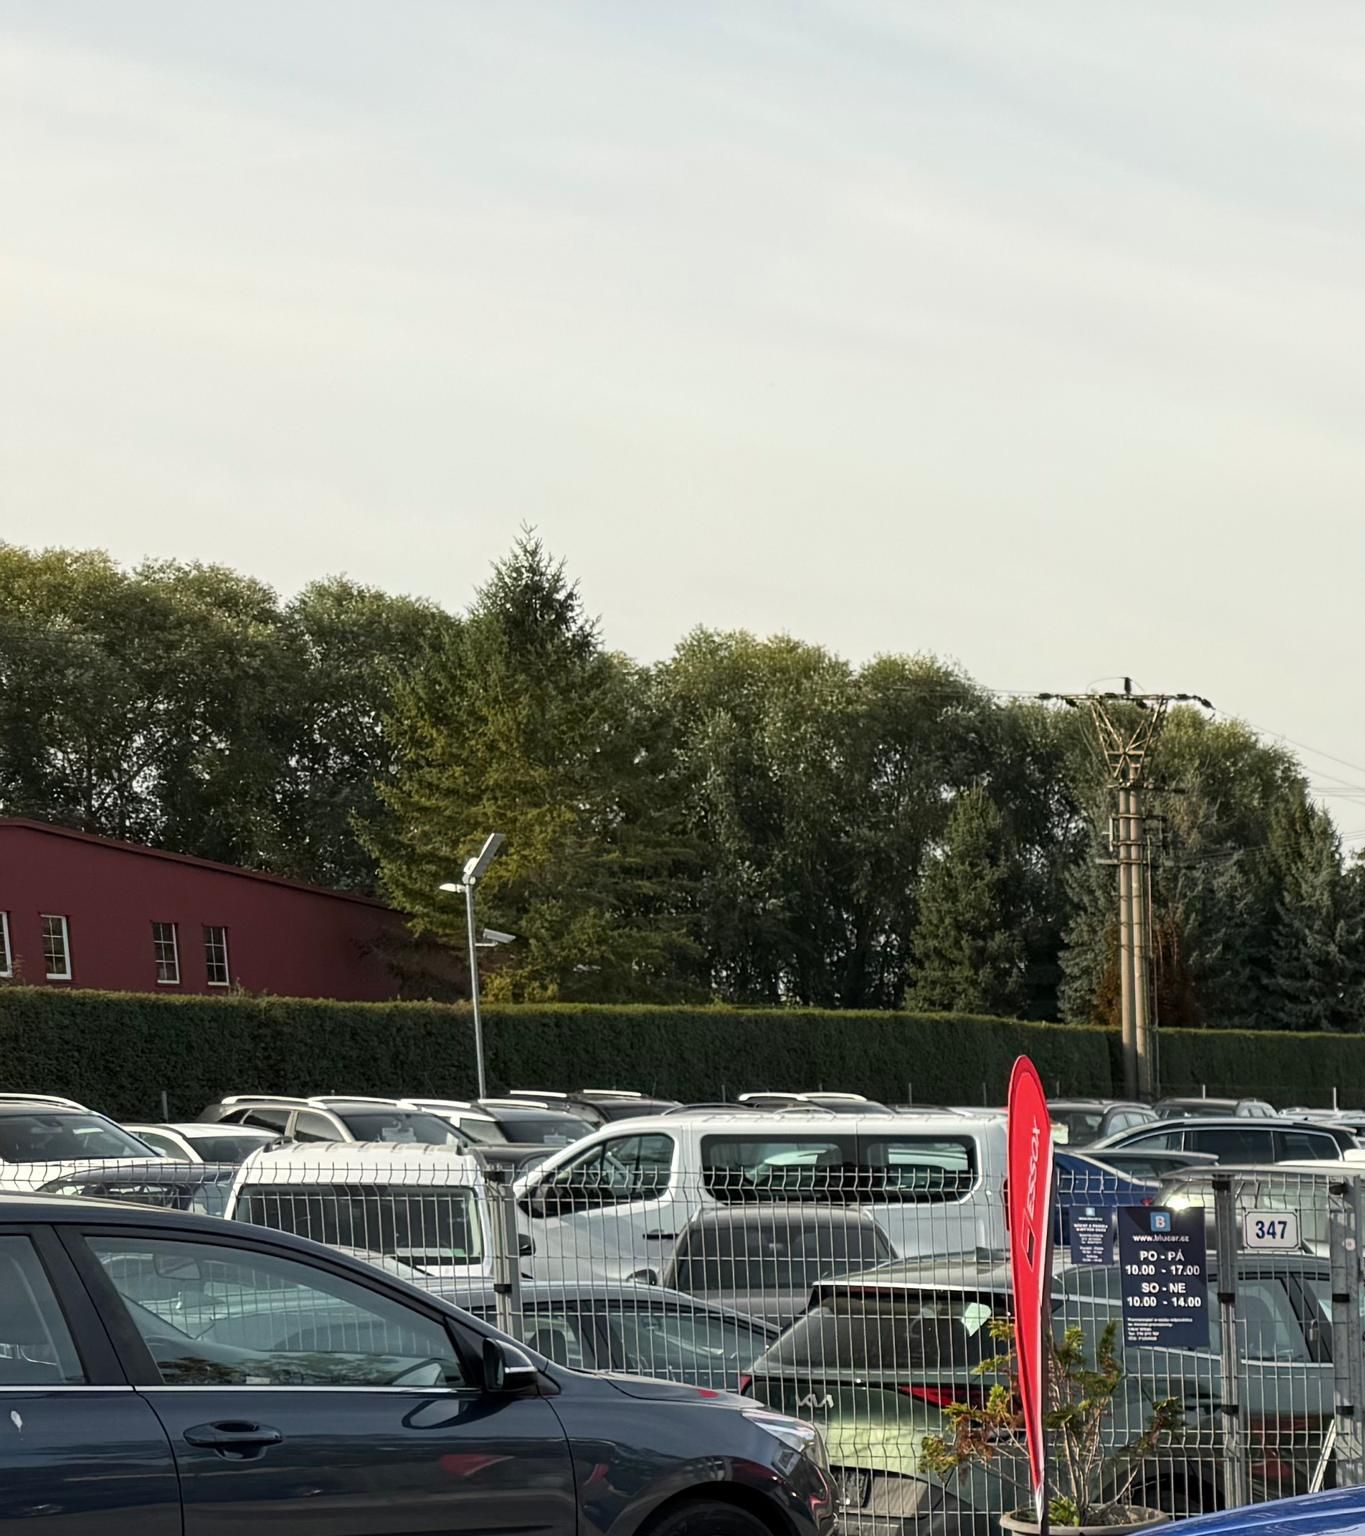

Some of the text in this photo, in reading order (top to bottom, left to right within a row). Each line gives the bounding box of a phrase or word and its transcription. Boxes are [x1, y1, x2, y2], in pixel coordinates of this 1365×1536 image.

[1026, 1115, 1041, 1221] ESSOX
[1155, 1215, 1166, 1228] B
[1255, 1220, 1288, 1239] 347
[1140, 1250, 1158, 1261] PO
[1168, 1248, 1185, 1261] PÁ
[1125, 1264, 1156, 1275] 10.00
[1170, 1264, 1200, 1275] 17.00
[1141, 1282, 1160, 1293] SO
[1169, 1282, 1187, 1293] NE
[1126, 1296, 1157, 1307] 10.00
[1171, 1296, 1202, 1307] 14.00
